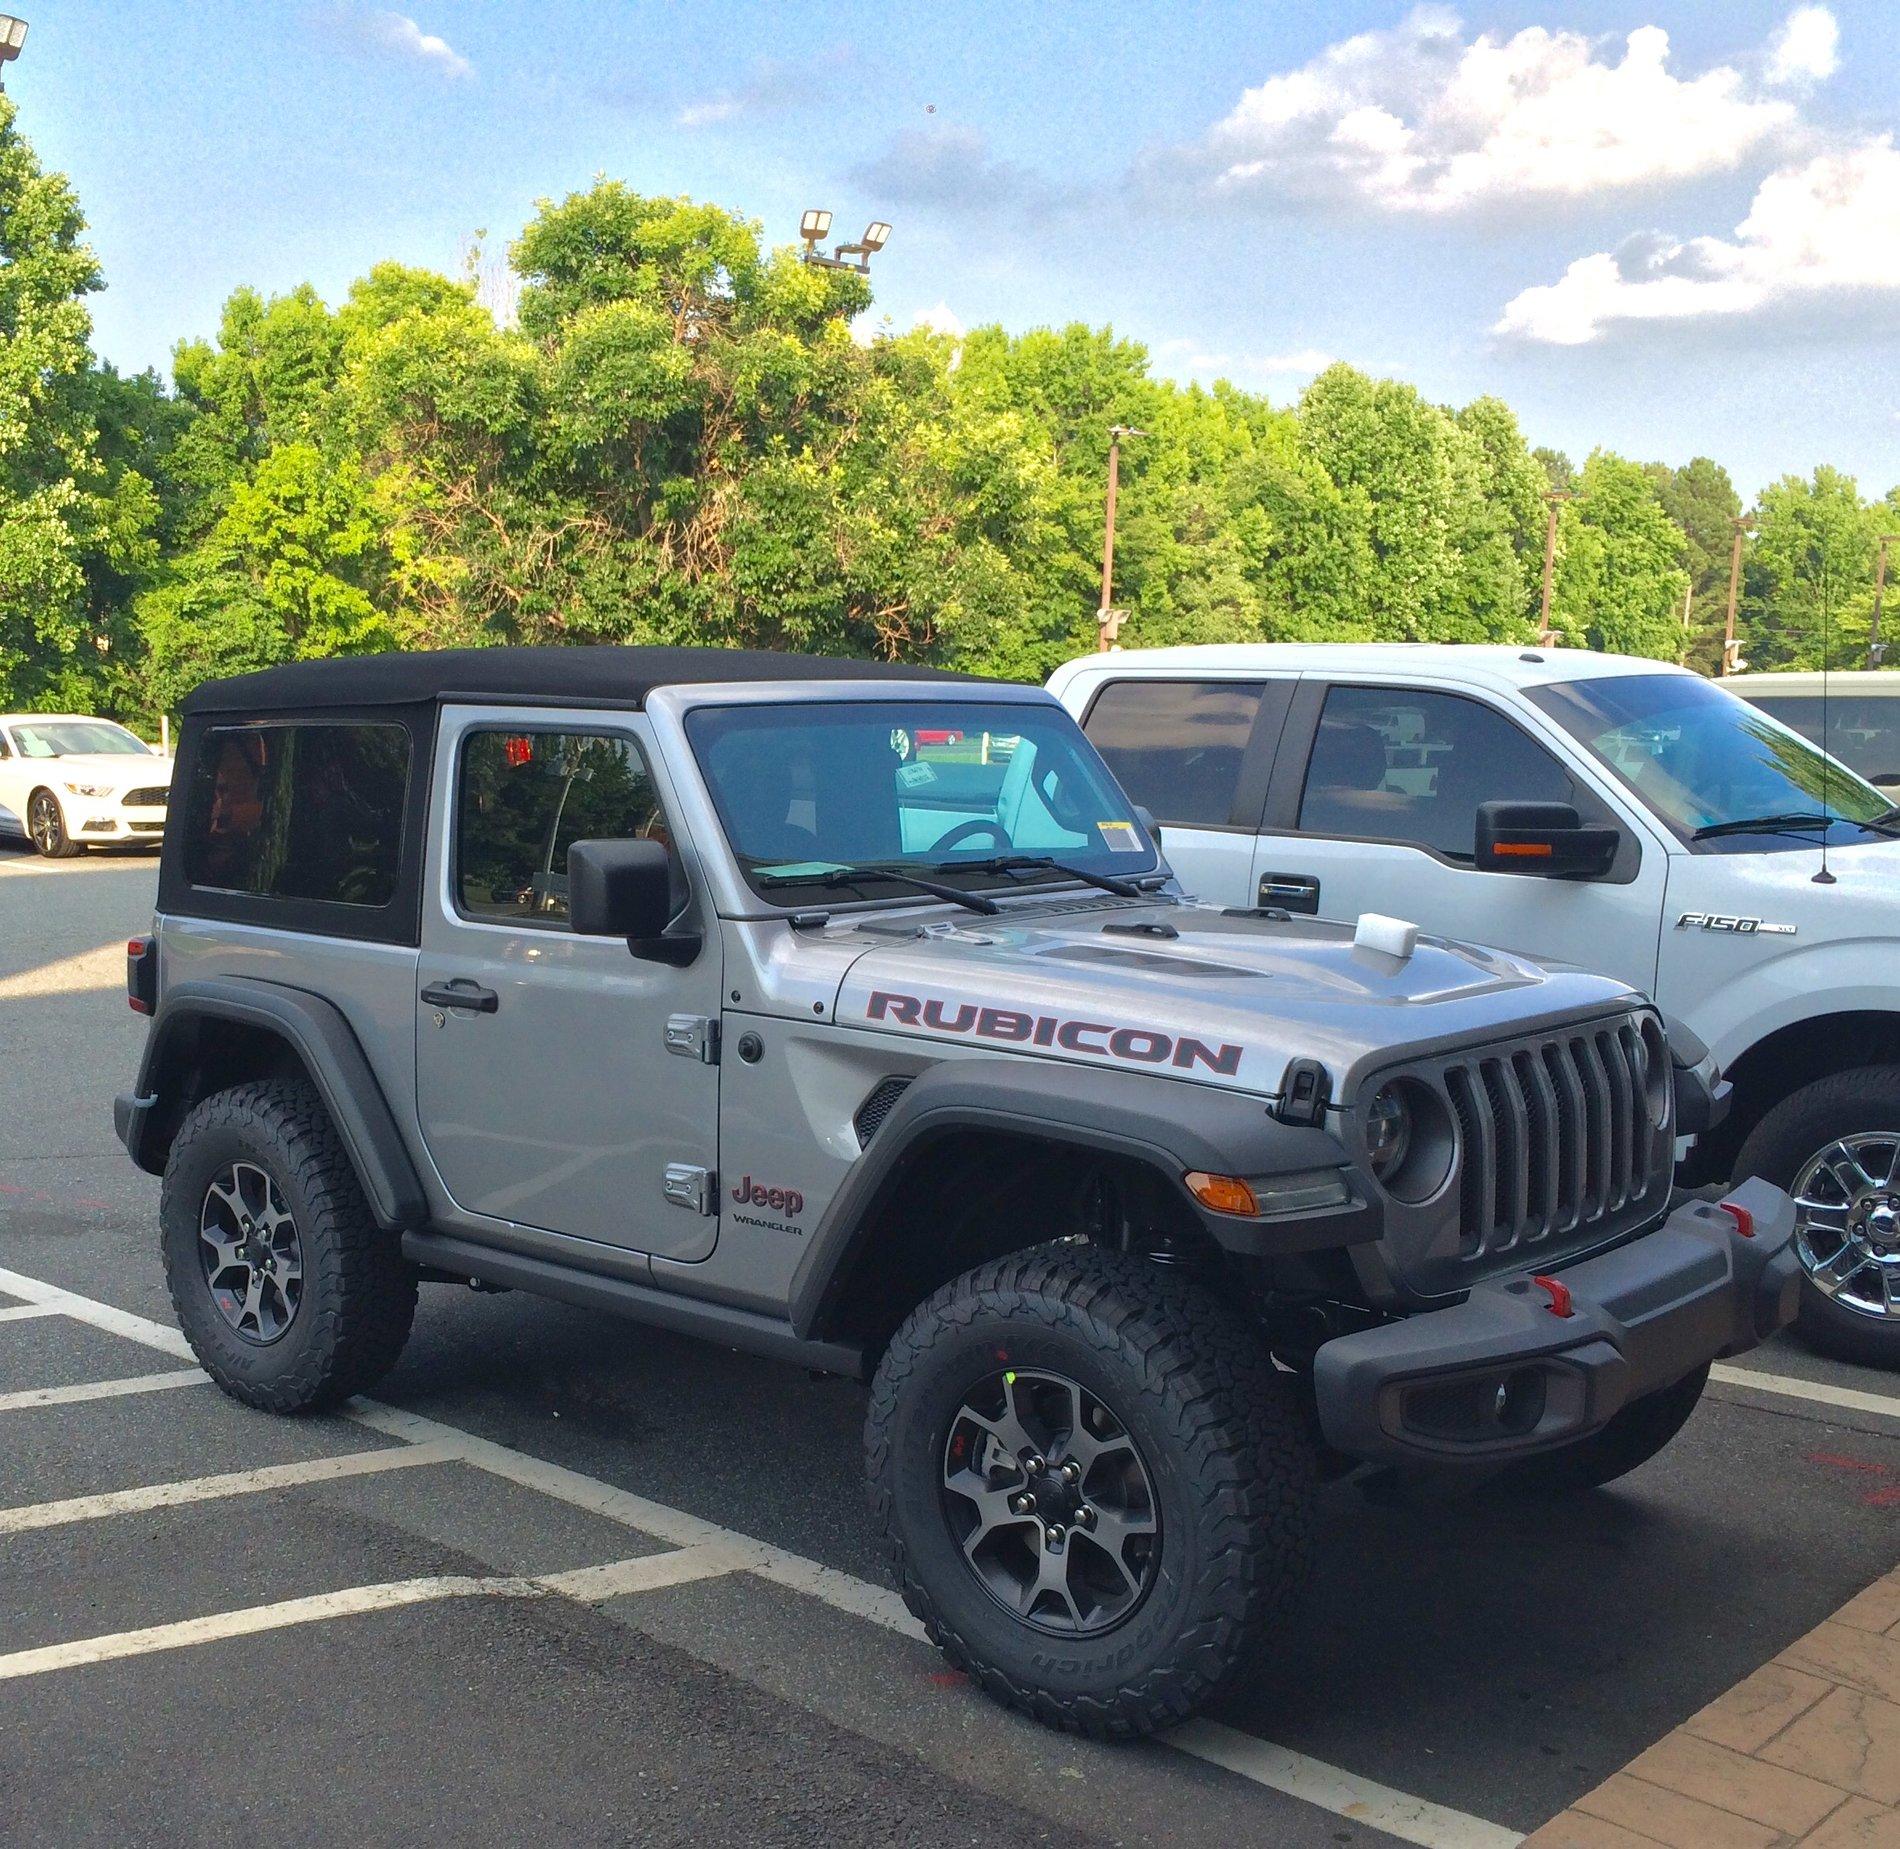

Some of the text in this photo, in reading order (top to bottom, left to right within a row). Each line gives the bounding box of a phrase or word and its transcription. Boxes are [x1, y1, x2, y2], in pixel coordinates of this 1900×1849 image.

[1676, 913, 1761, 934] F-150
[866, 990, 1244, 1076] RUBICON
[732, 1175, 803, 1218] Jeep
[733, 1213, 803, 1236] WRANGLER
